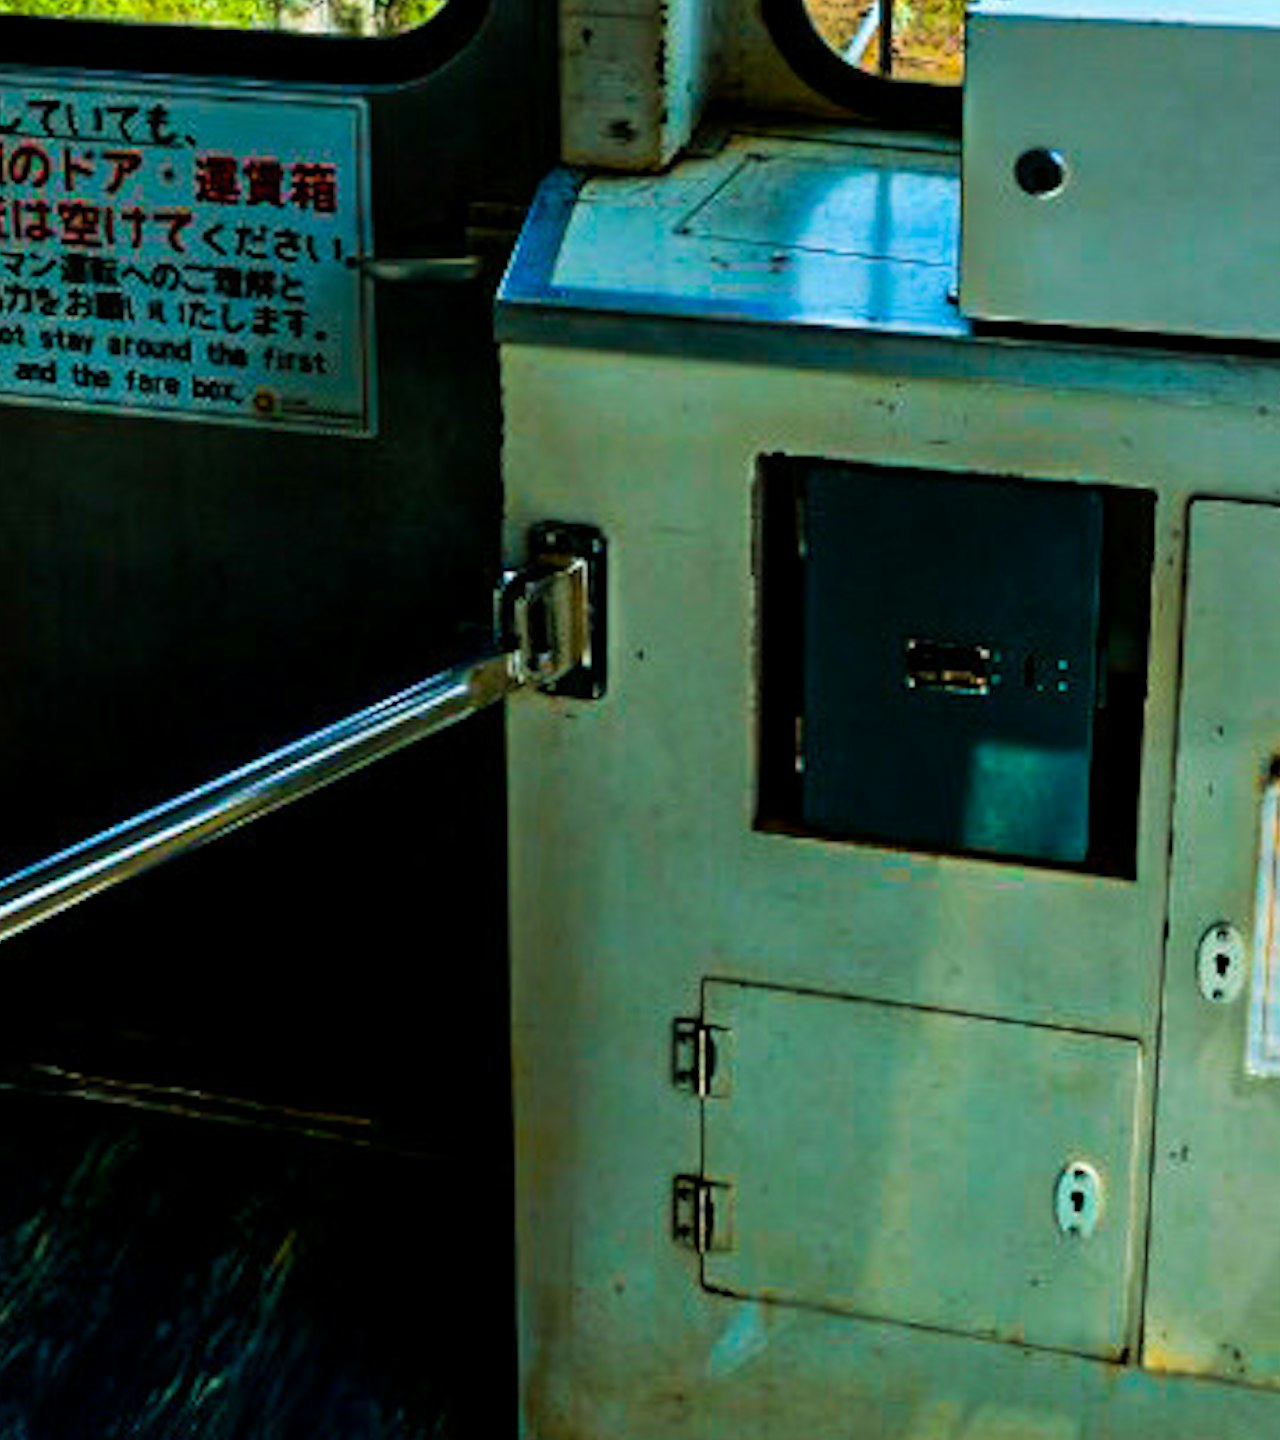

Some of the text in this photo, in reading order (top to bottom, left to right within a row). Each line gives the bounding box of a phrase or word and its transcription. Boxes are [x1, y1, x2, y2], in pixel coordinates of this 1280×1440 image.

[40, 328, 94, 356] stay
[109, 335, 191, 363] around
[207, 342, 248, 368] the
[264, 346, 327, 375] first
[16, 360, 56, 383] and
[72, 364, 110, 387] the
[126, 369, 180, 397] fare
